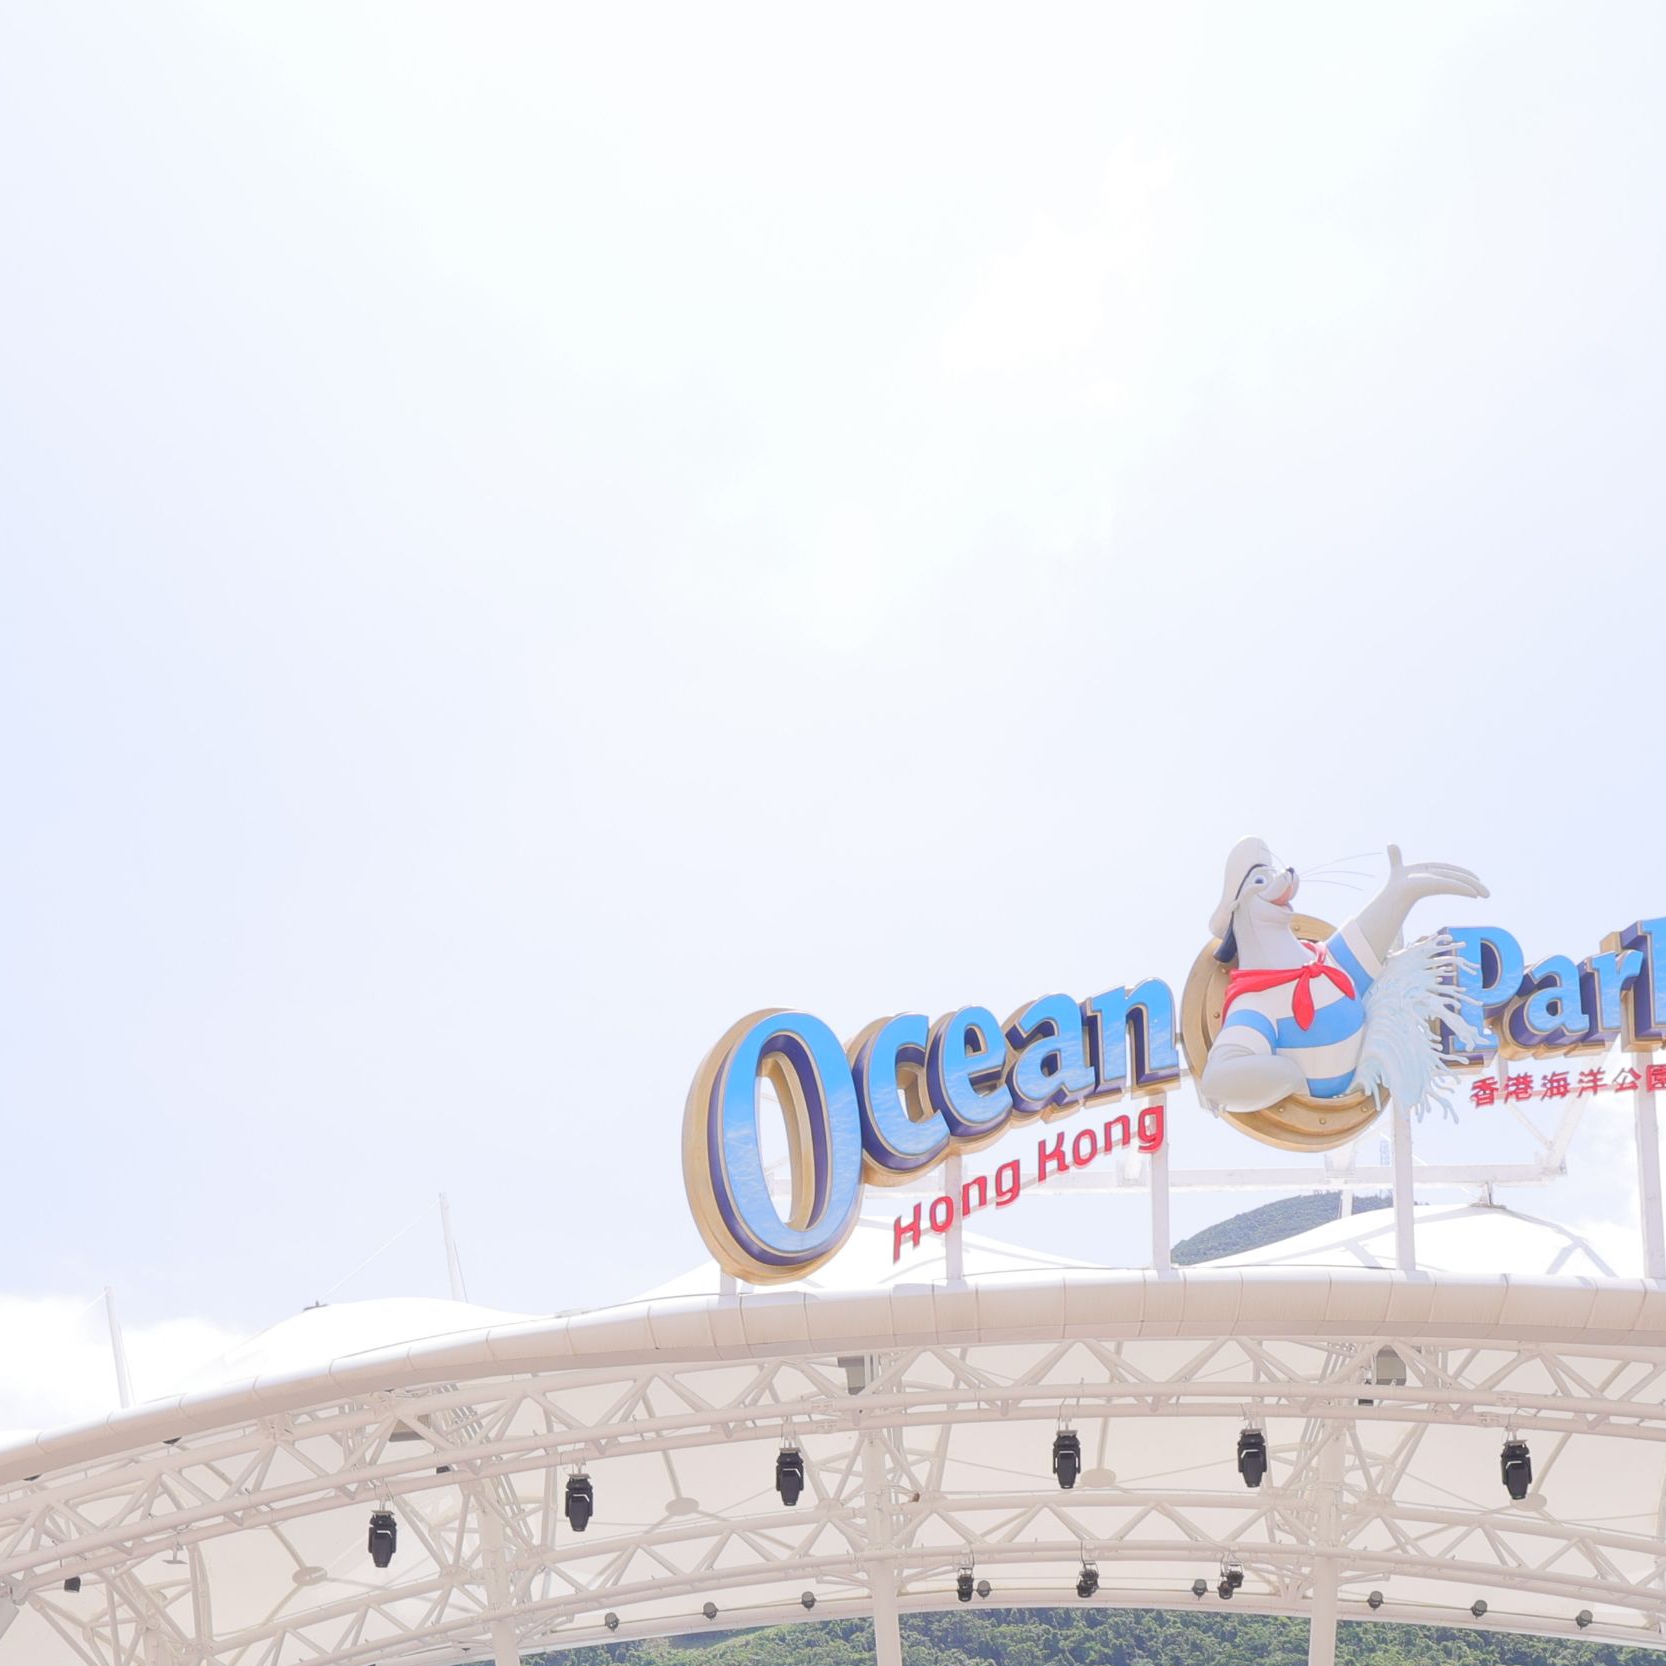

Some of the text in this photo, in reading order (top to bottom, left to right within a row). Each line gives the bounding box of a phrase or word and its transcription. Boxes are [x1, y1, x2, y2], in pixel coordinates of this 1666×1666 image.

[685, 977, 1181, 1284] Ocean
[893, 1103, 1165, 1265] Hong Kong
